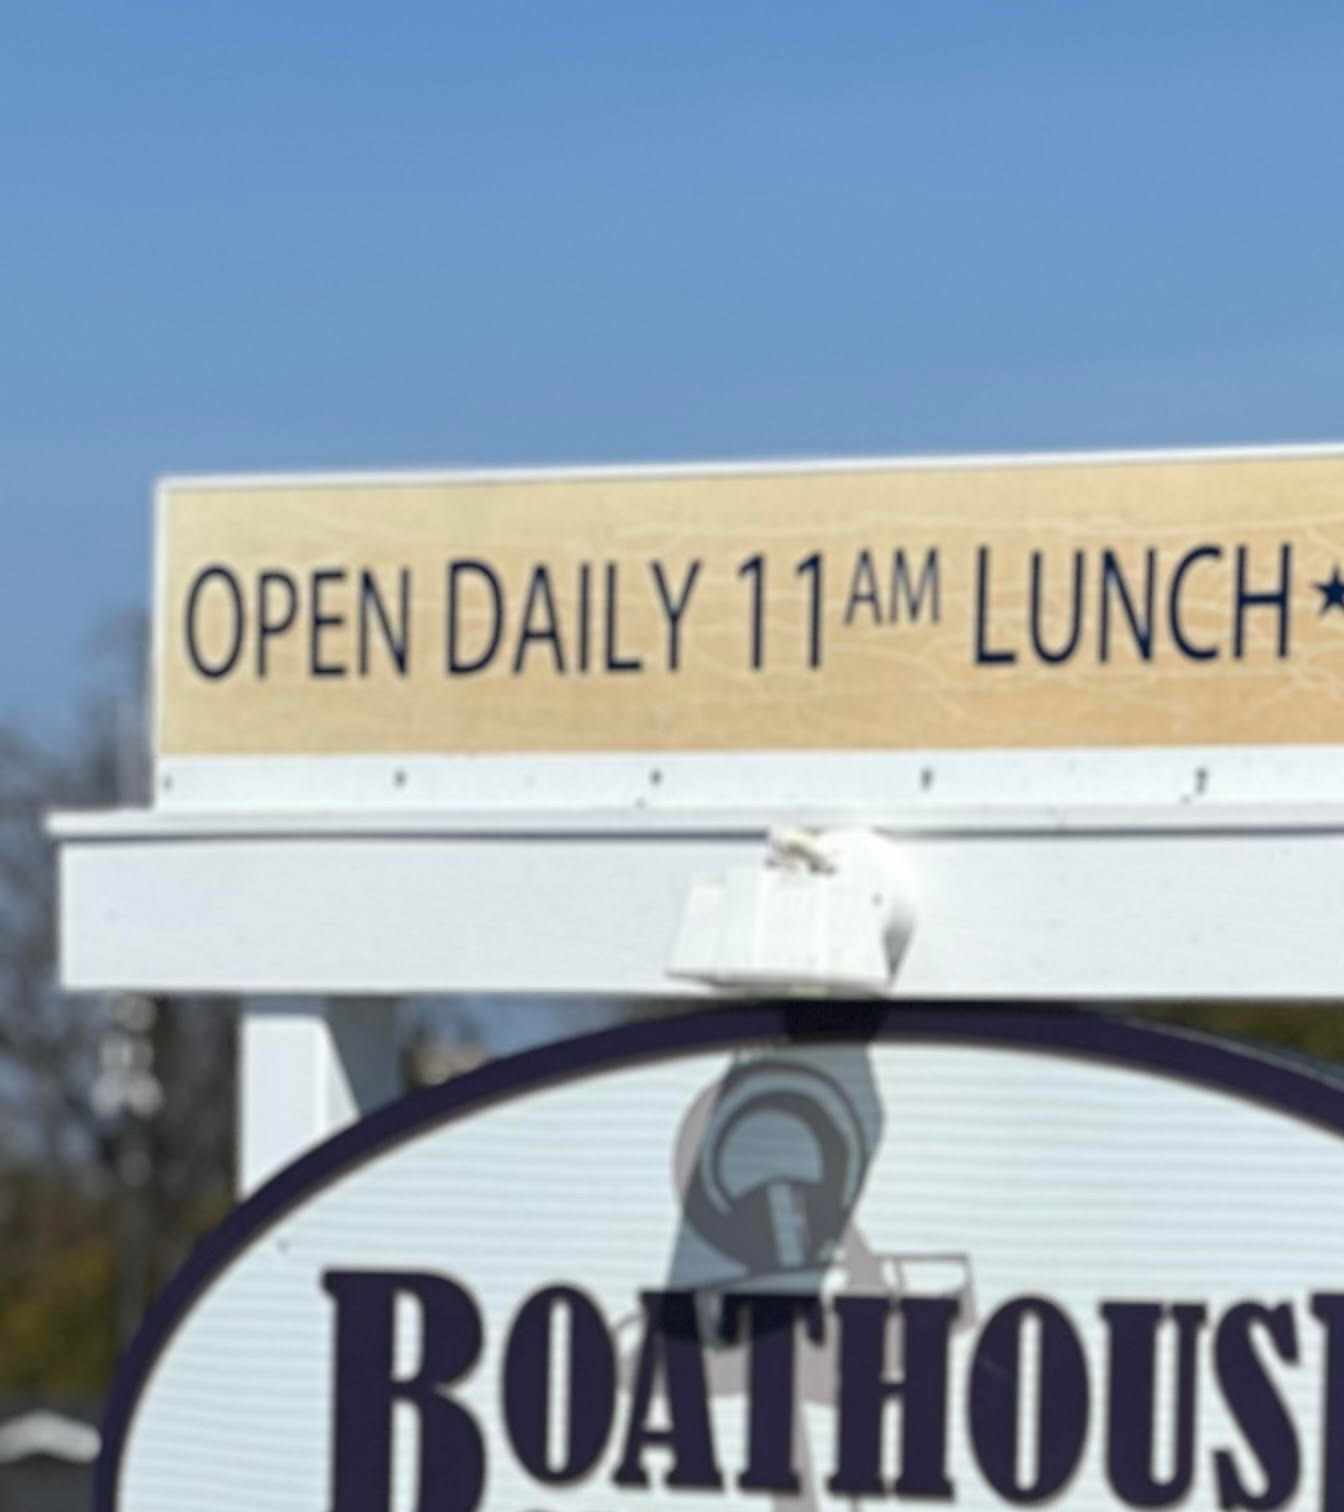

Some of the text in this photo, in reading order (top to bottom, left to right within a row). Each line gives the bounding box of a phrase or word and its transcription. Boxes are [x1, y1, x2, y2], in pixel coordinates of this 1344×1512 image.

[183, 563, 411, 682] OPEN
[444, 557, 703, 677] DAILY
[972, 541, 1293, 667] LUNCH
